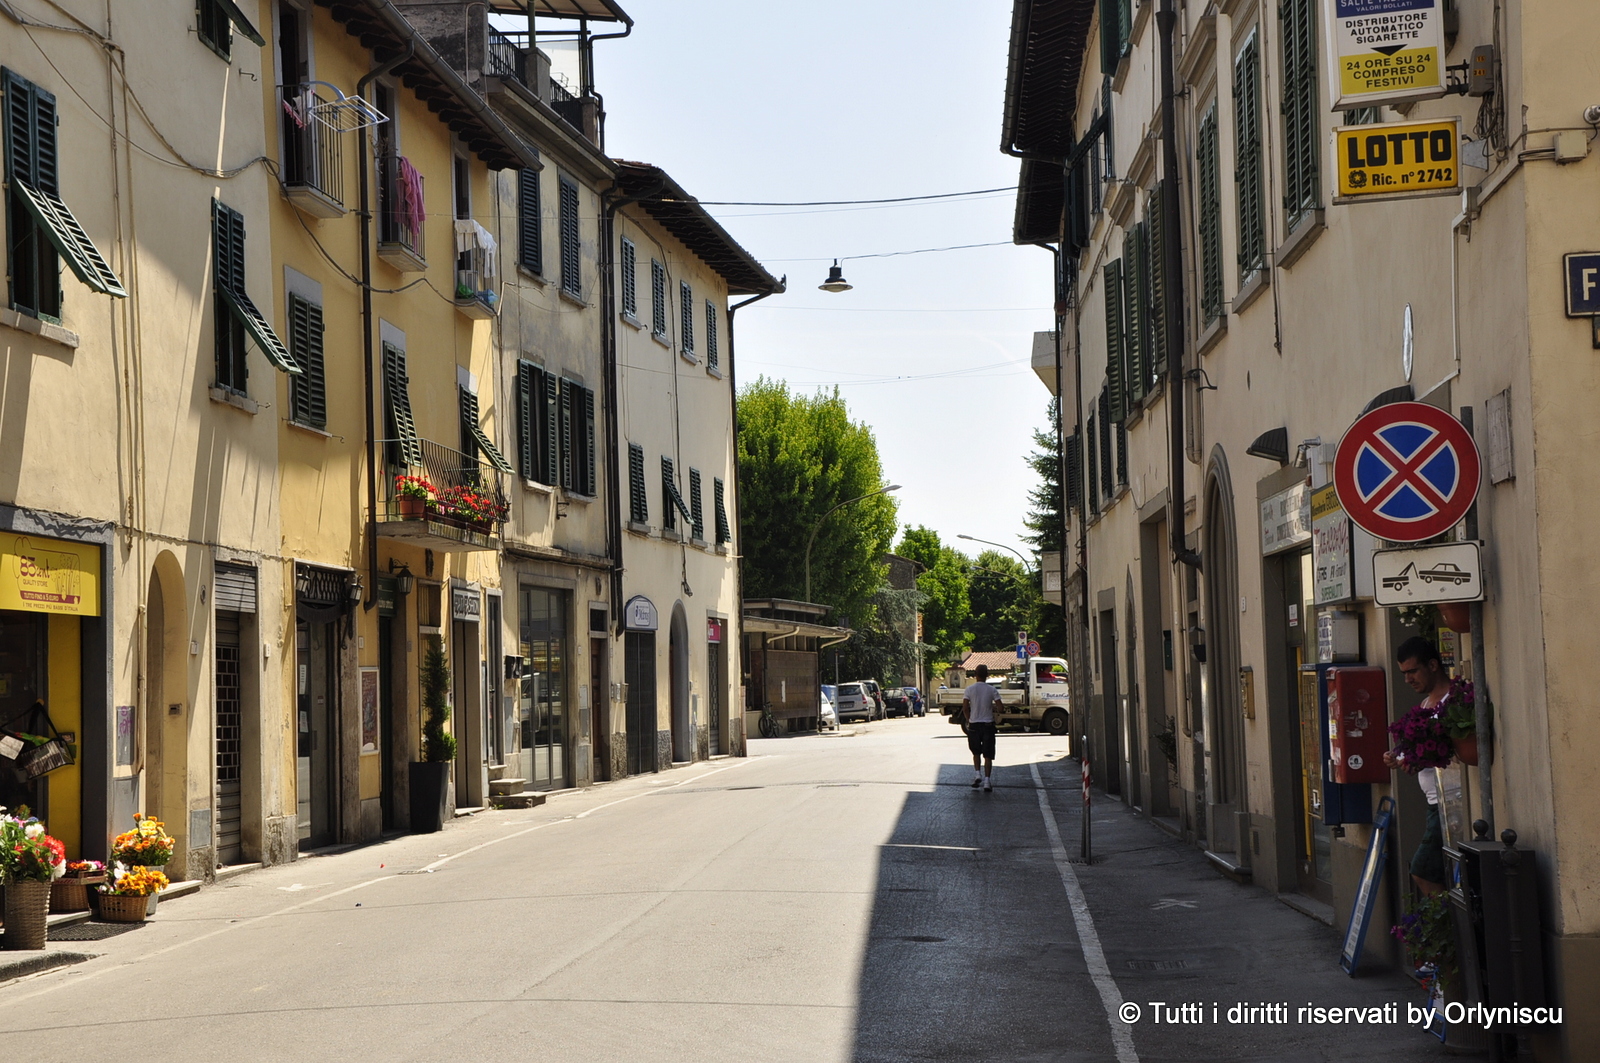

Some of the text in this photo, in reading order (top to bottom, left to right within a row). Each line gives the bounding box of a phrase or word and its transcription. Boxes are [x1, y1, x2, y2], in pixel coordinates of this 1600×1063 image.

[1345, 12, 1428, 29] DISTRIBUTORE
[1350, 21, 1424, 37] AUTOMATICO
[1356, 30, 1419, 45] SIGARETTE
[1346, 53, 1431, 71] 24 ORE SU 24
[1353, 64, 1426, 80] COMPRESO
[1366, 75, 1414, 88] FESTIVI
[1347, 129, 1452, 169] LOTTO
[1371, 168, 1452, 186] Ric. n° 2742
[1582, 268, 1597, 301] F
